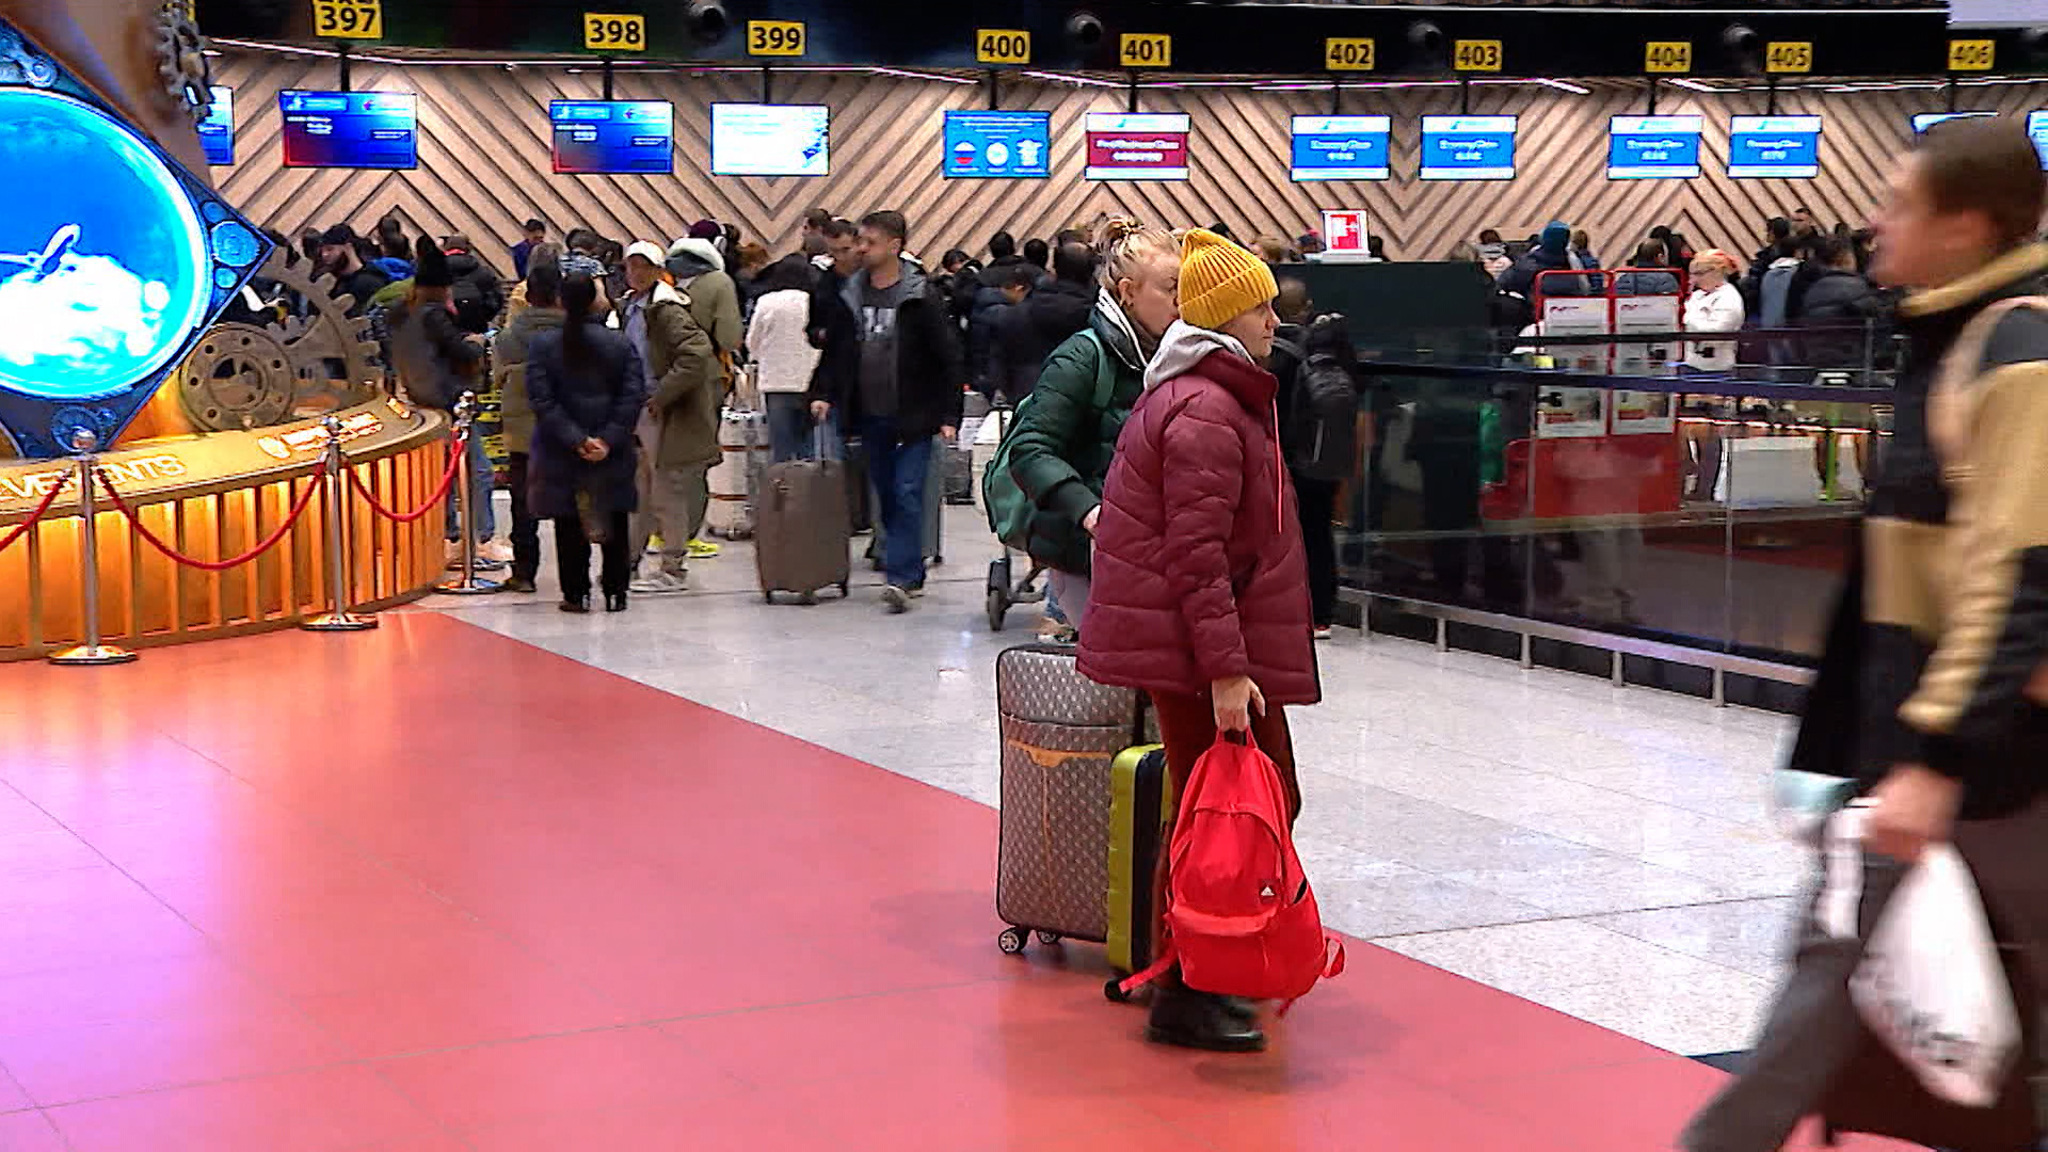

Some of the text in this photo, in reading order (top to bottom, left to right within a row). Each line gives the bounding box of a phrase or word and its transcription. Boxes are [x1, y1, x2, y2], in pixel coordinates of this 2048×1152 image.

[321, 5, 376, 32] 397
[590, 19, 641, 44] 398
[752, 27, 801, 49] 399
[981, 35, 1026, 58] 400
[1124, 39, 1165, 61] 401
[1330, 44, 1370, 64] 402
[1457, 46, 1498, 66] 403
[1647, 46, 1687, 66] 404
[1953, 45, 1990, 65] 406
